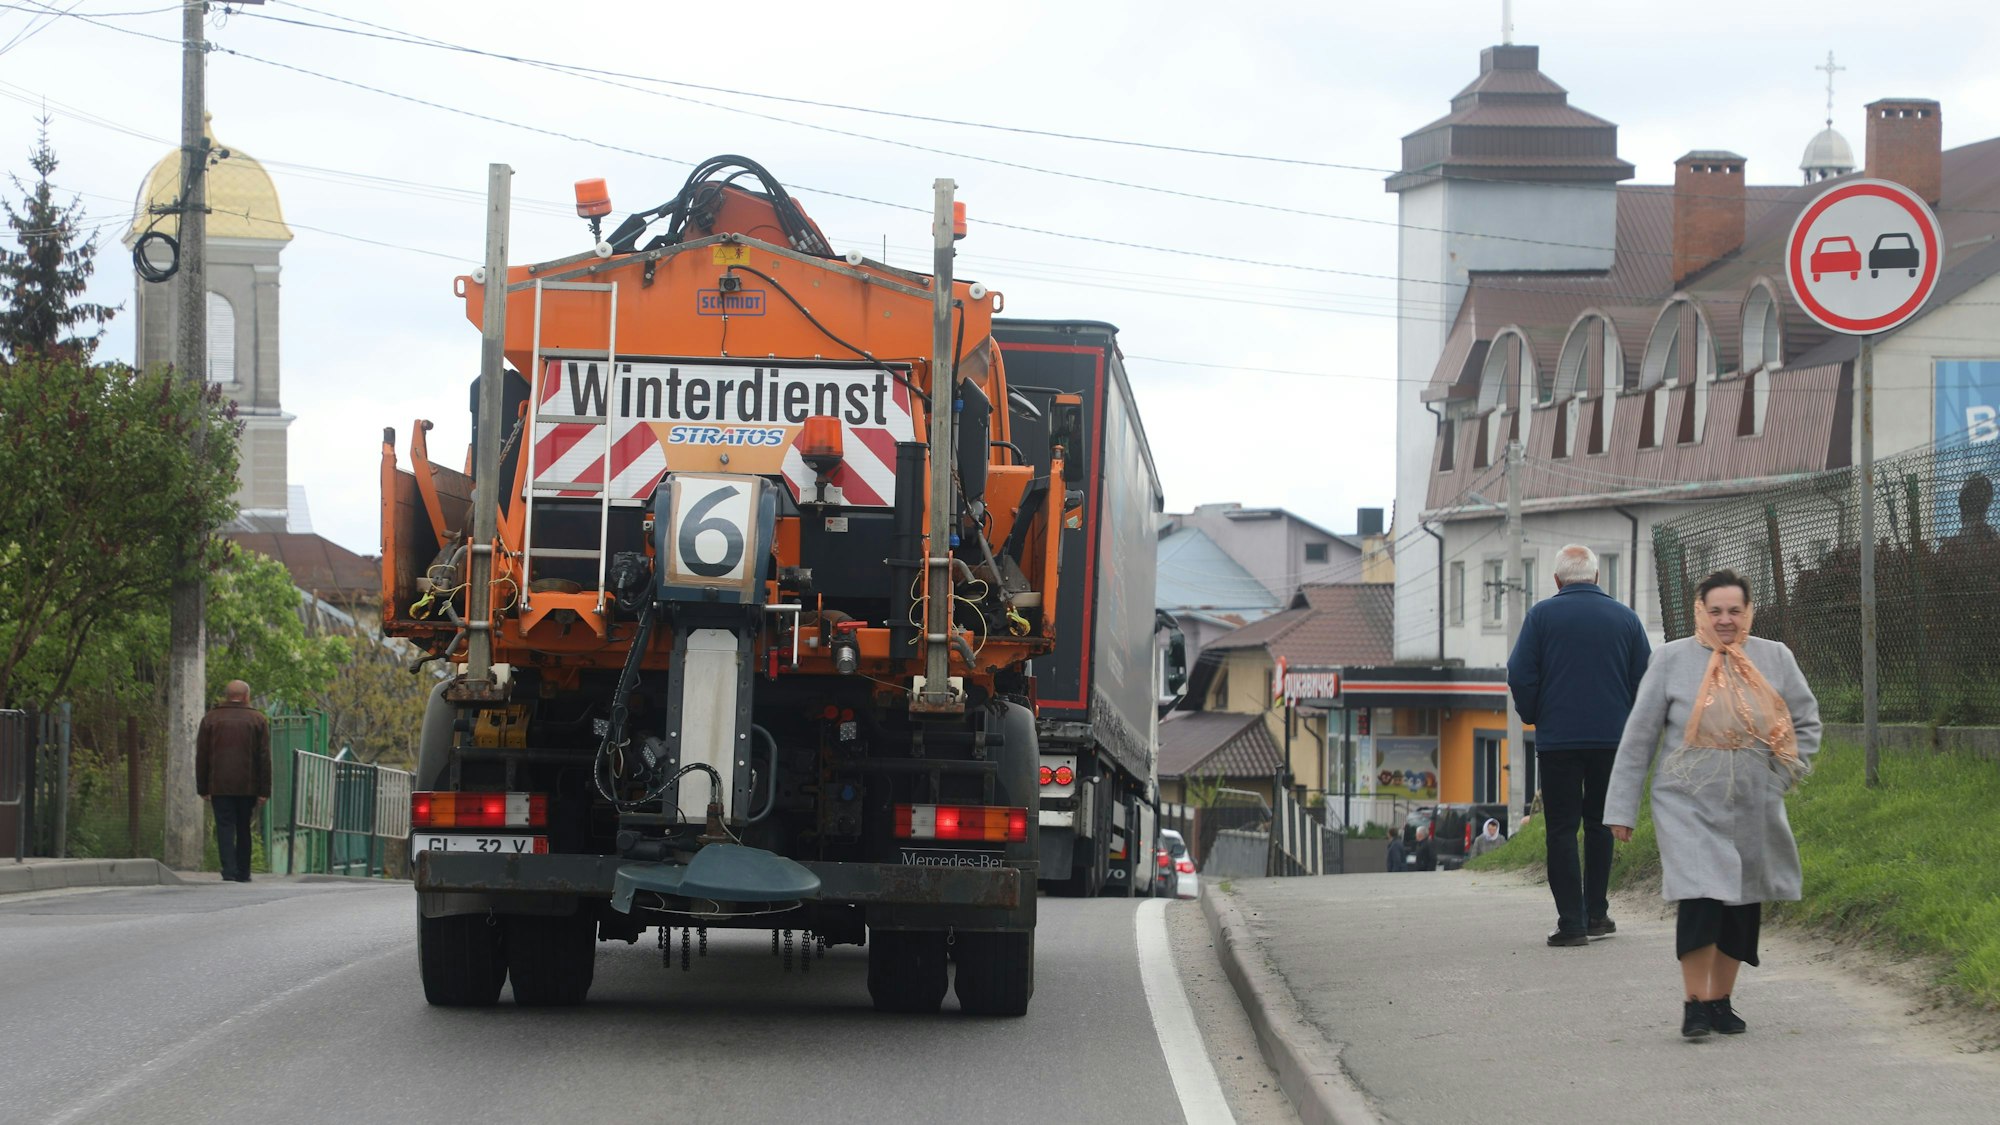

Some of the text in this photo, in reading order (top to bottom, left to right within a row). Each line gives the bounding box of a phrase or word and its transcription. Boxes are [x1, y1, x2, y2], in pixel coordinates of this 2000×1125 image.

[702, 295, 761, 310] SCHMIDT
[567, 362, 888, 426] Winterdienst
[668, 425, 786, 446] STRATOS
[678, 484, 745, 578] 6
[1285, 672, 1335, 708] рукавичка
